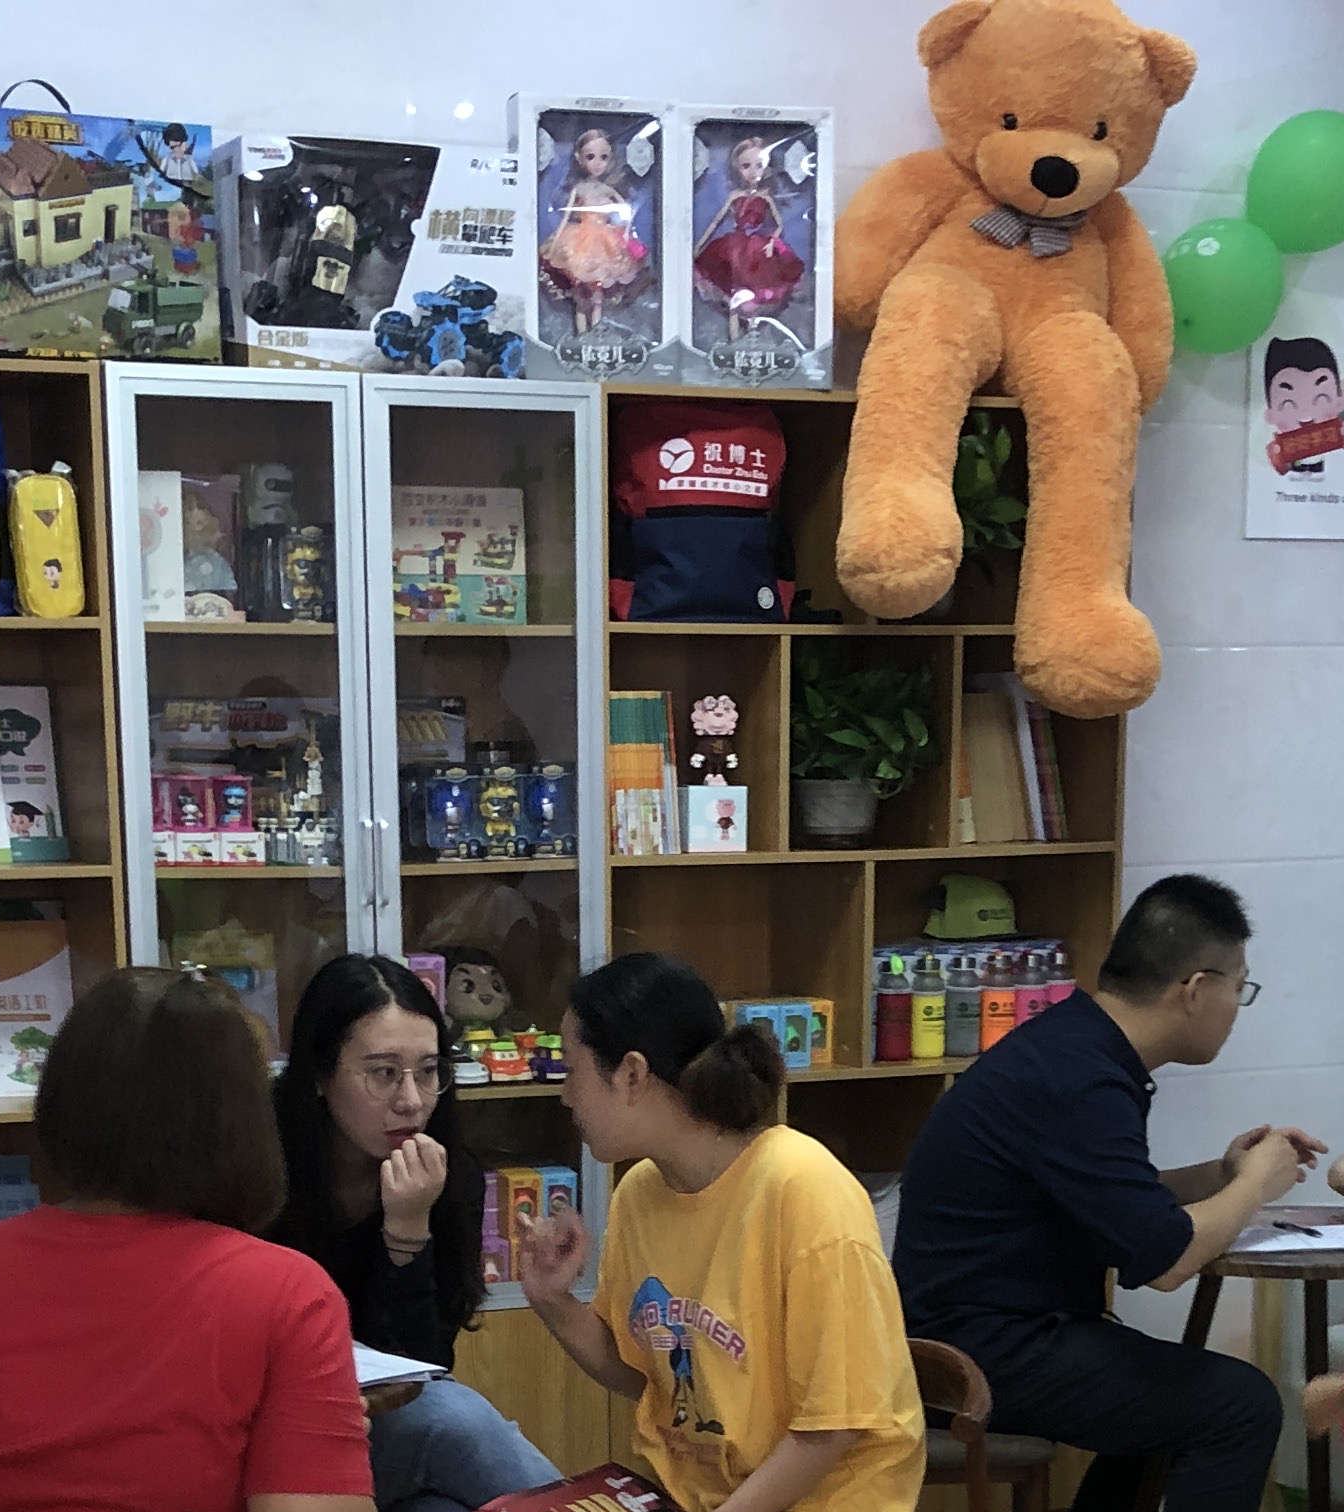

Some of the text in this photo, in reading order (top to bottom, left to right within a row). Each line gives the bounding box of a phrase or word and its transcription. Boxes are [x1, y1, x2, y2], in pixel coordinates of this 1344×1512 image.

[256, 328, 311, 348] 合金版
[703, 441, 767, 468] 祝博士
[1275, 490, 1307, 503] Three
[1309, 491, 1340, 504] kinds
